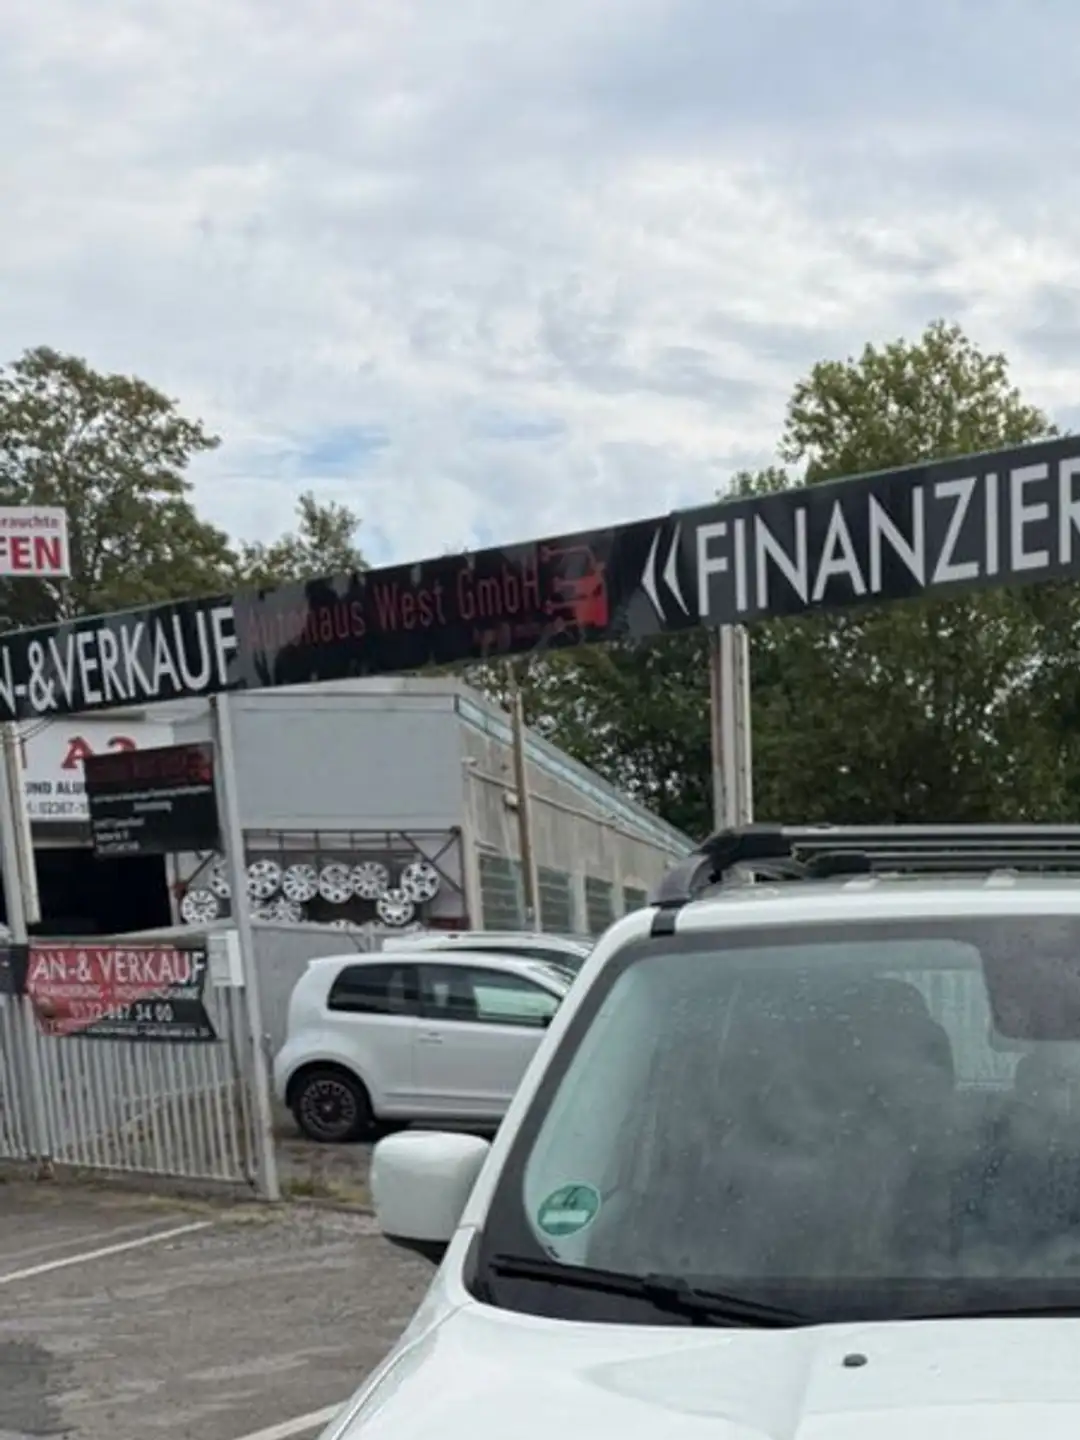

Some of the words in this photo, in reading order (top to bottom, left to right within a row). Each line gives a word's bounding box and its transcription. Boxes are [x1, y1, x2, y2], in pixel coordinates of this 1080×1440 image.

[373, 581, 447, 634] West
[457, 559, 541, 621] GmbH
[96, 950, 206, 983] VERKAUF
